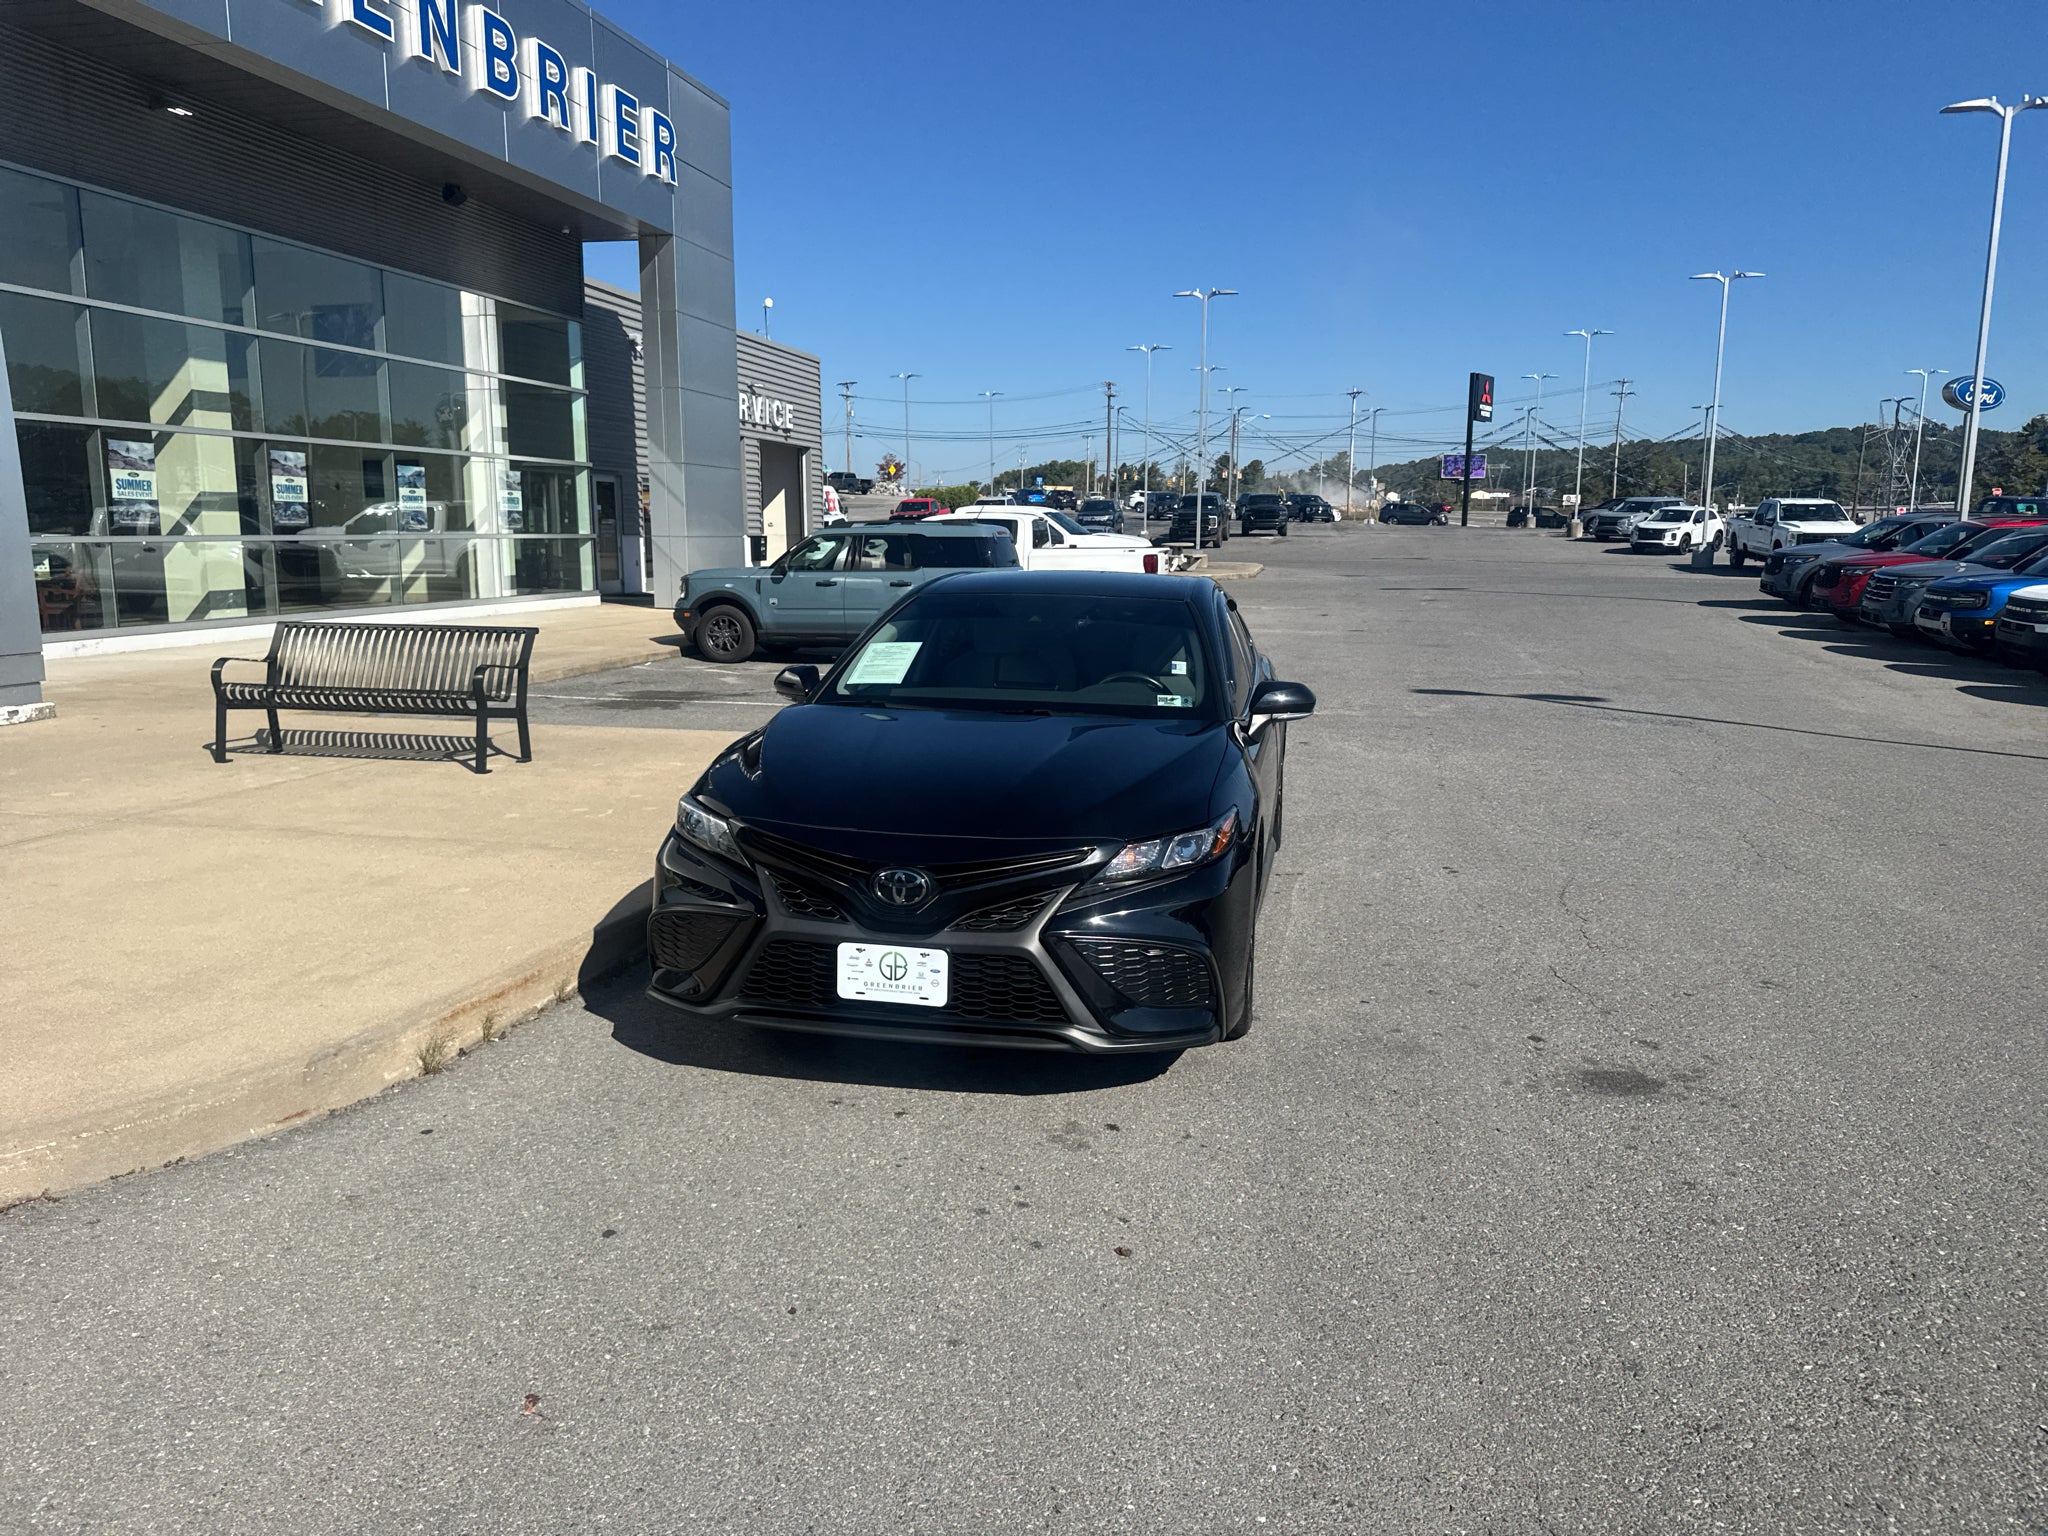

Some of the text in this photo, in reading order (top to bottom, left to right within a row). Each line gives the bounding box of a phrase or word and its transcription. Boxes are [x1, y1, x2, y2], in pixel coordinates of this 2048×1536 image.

[312, 0, 679, 187] NBRIER
[1965, 383, 1997, 404] Frd
[116, 478, 152, 491] SUMMER
[276, 483, 303, 495] SUMMER
[879, 951, 907, 981] GB
[864, 981, 922, 991] GREENBRIER
